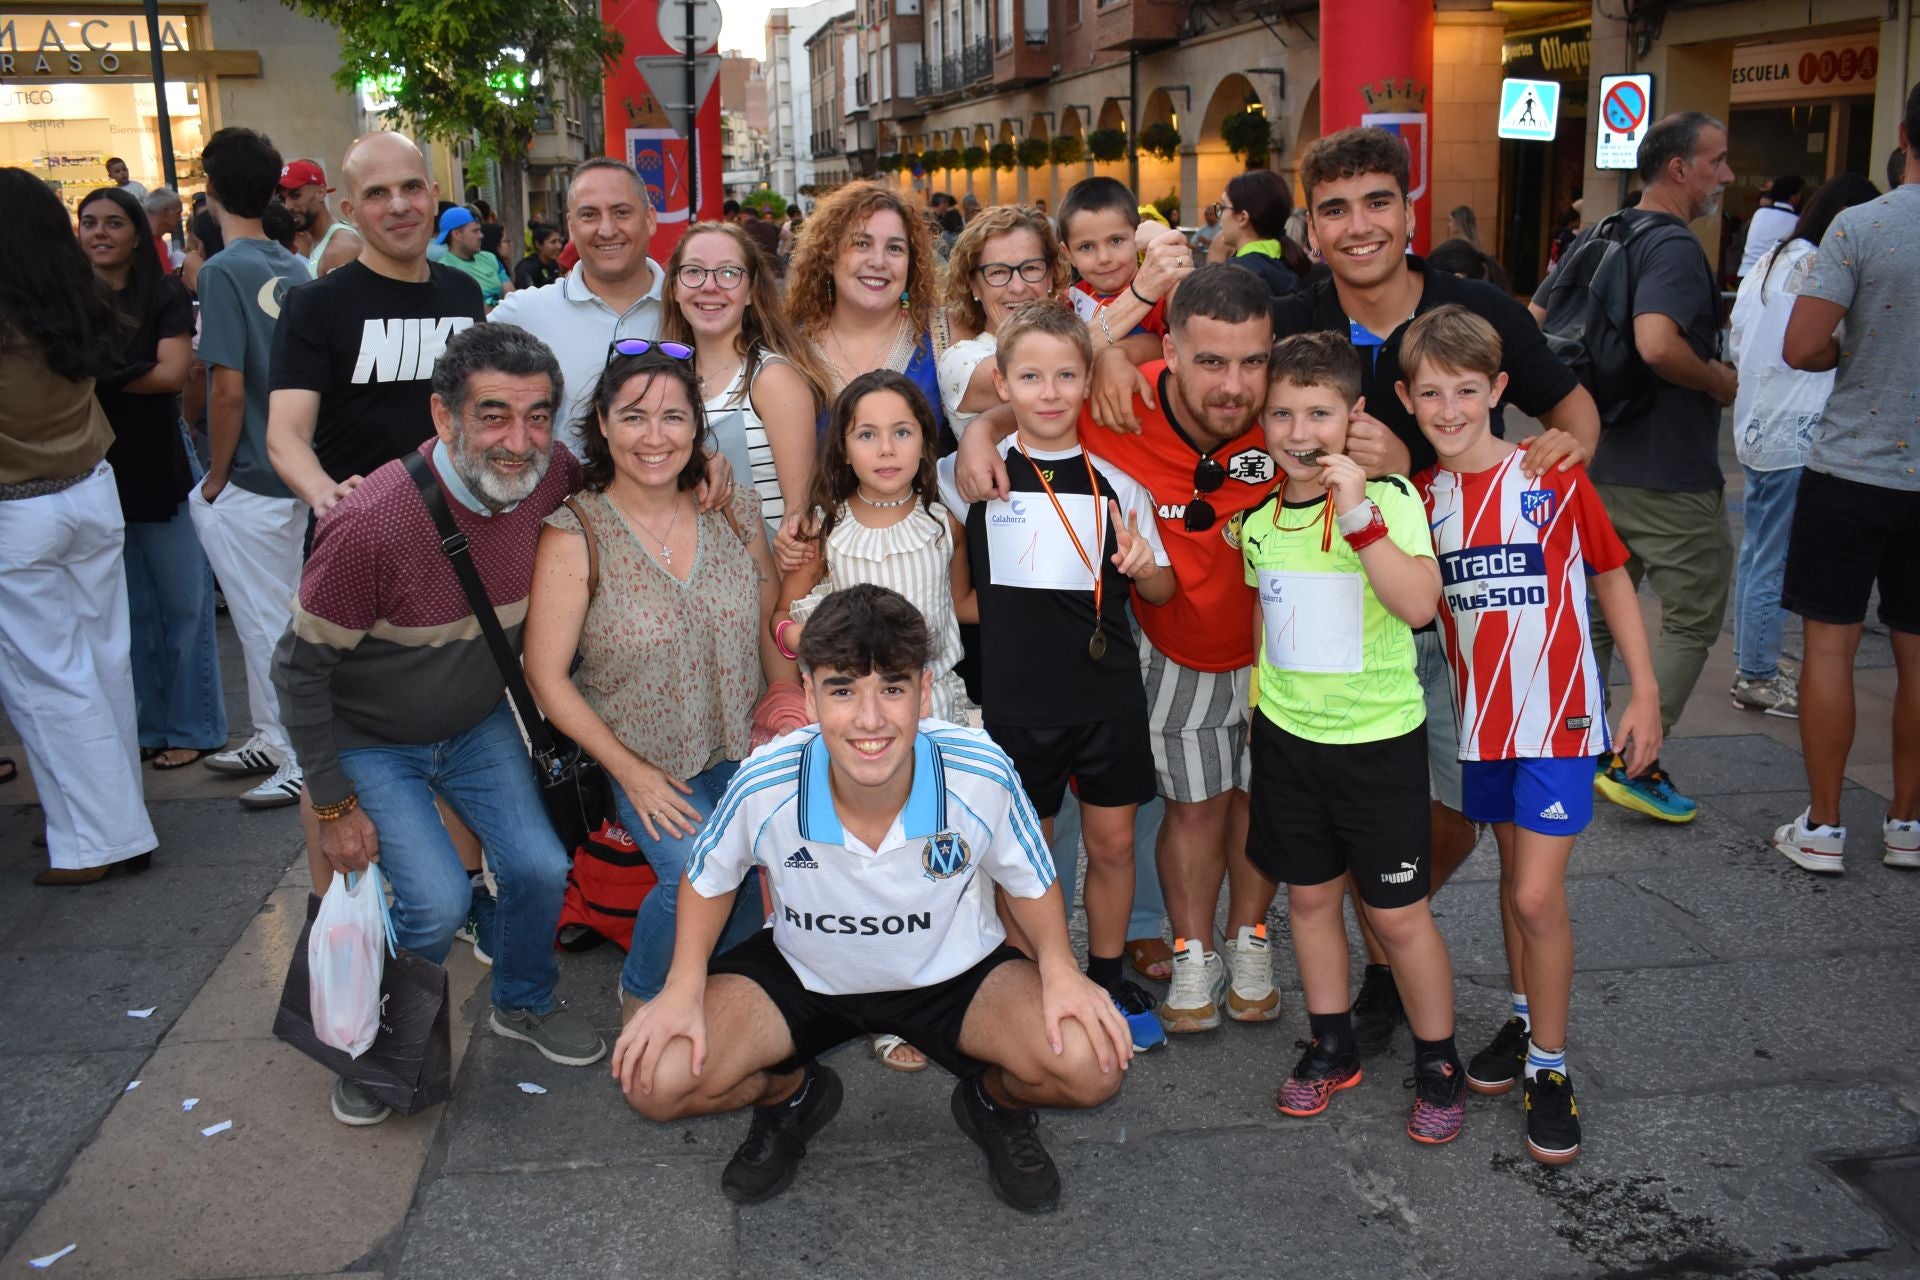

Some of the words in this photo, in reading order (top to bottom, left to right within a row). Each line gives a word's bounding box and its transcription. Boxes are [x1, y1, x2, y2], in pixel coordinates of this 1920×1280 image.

[1731, 64, 1790, 84] ESCUELA
[351, 316, 475, 385] NIK
[992, 515, 1026, 523] Calahorra
[1445, 548, 1527, 581] Trade
[1447, 585, 1546, 613] Plus500
[1540, 811, 1569, 820] adidas
[784, 860, 819, 869] adidas
[784, 905, 931, 936] RICSSON
